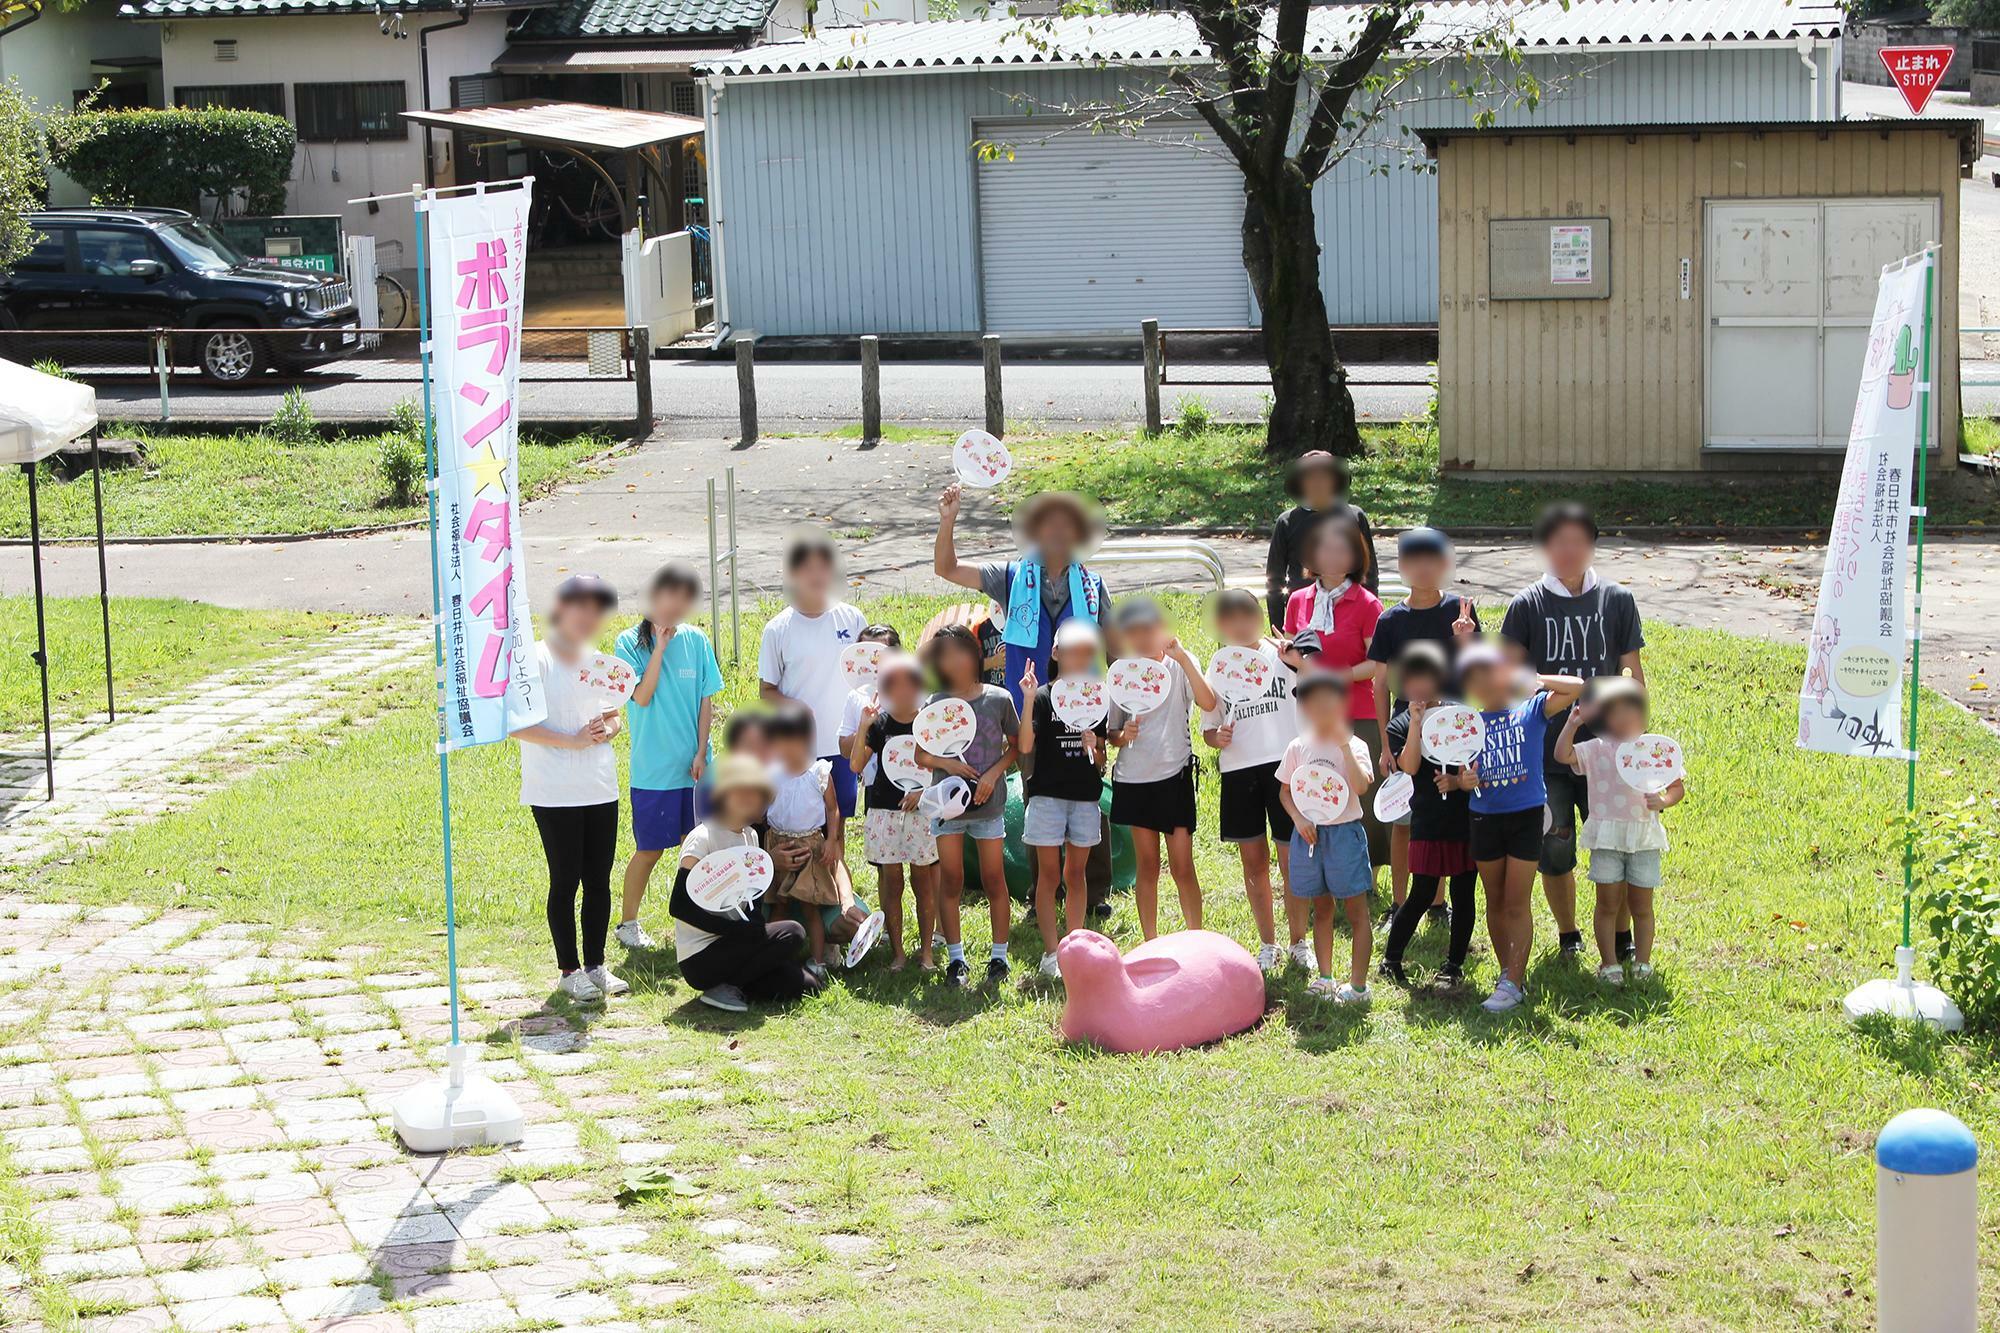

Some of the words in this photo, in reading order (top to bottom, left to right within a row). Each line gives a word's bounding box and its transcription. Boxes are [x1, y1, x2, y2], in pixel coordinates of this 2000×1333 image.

[1895, 54, 1941, 70] 止まれ
[1903, 73, 1934, 86] STOP
[450, 503, 461, 581] 社会福祉法人
[1545, 612, 1606, 661] DAY'S
[451, 594, 474, 737] 春日井市社会福祉協議会
